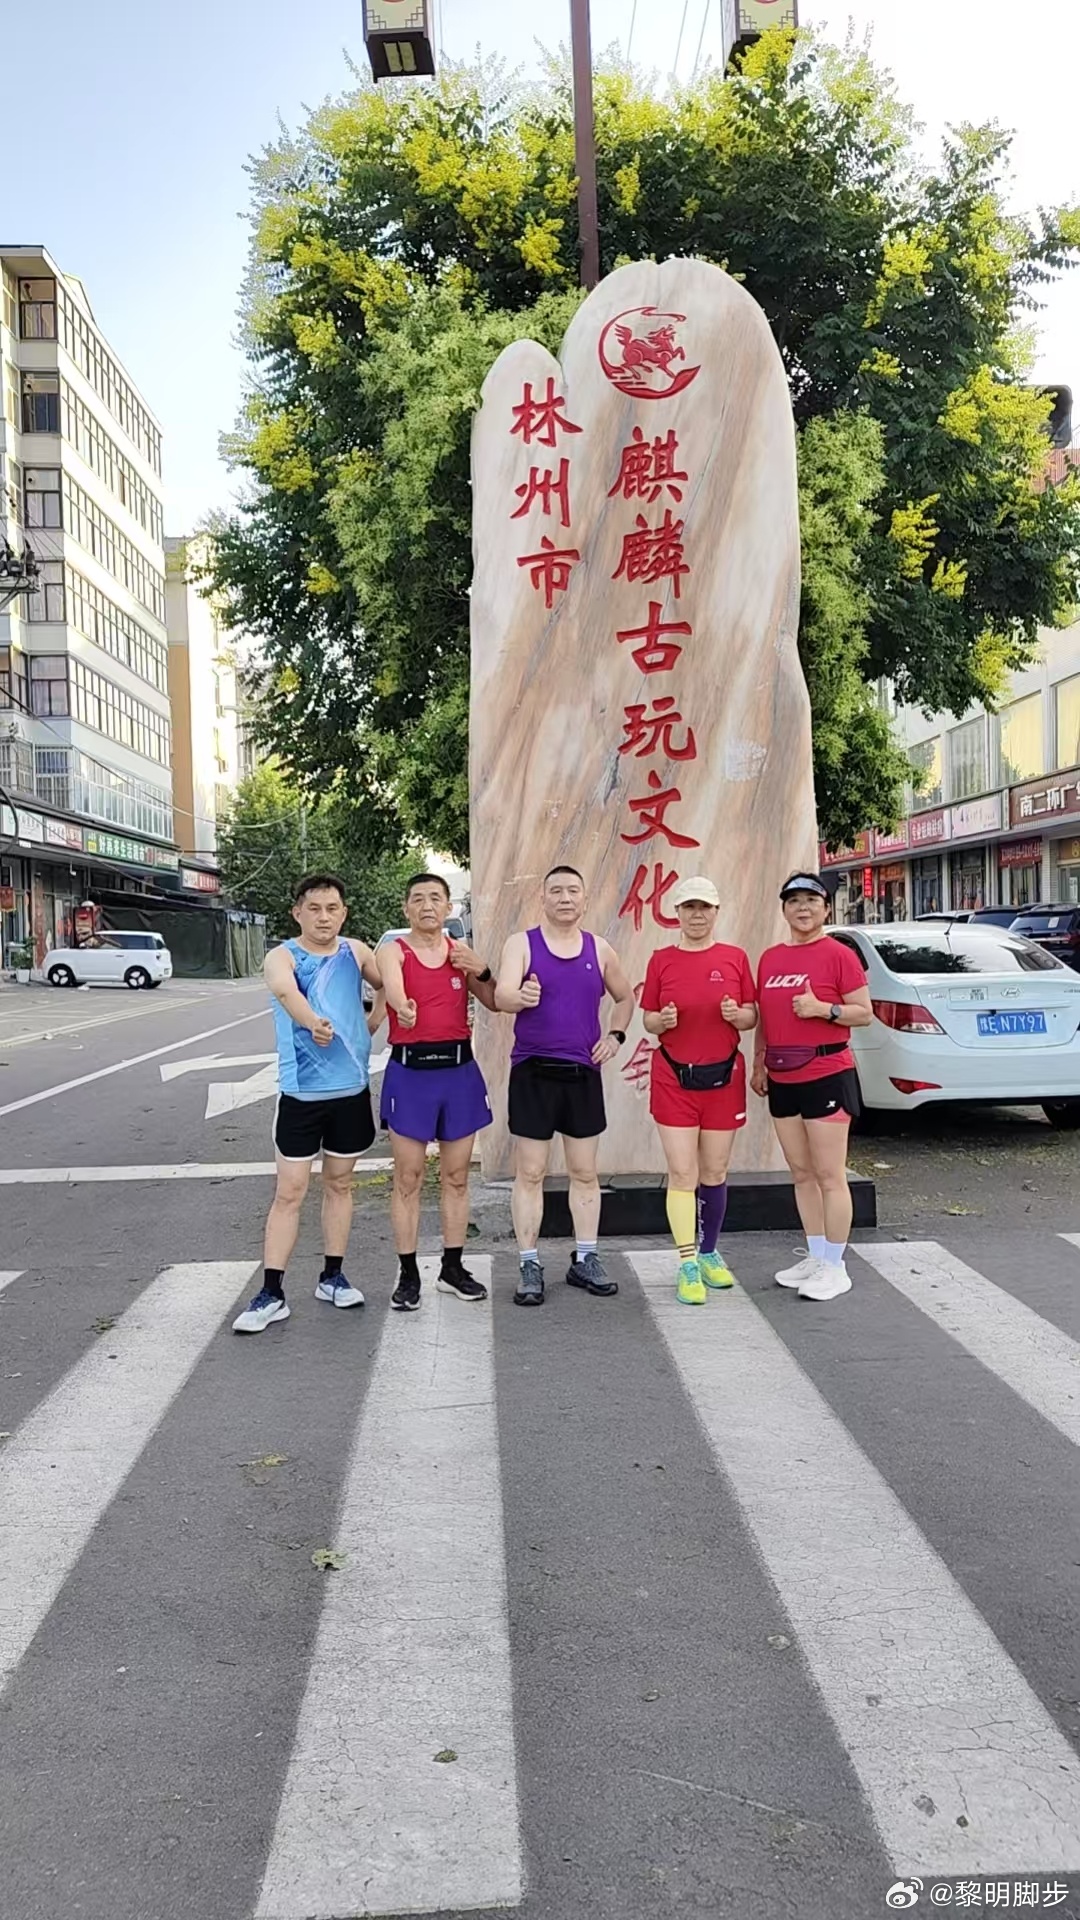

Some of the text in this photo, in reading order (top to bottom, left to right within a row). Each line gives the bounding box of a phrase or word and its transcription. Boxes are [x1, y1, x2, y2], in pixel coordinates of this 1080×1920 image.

[509, 377, 583, 608] 林州市
[608, 426, 700, 1091] 麒麟古玩文化
